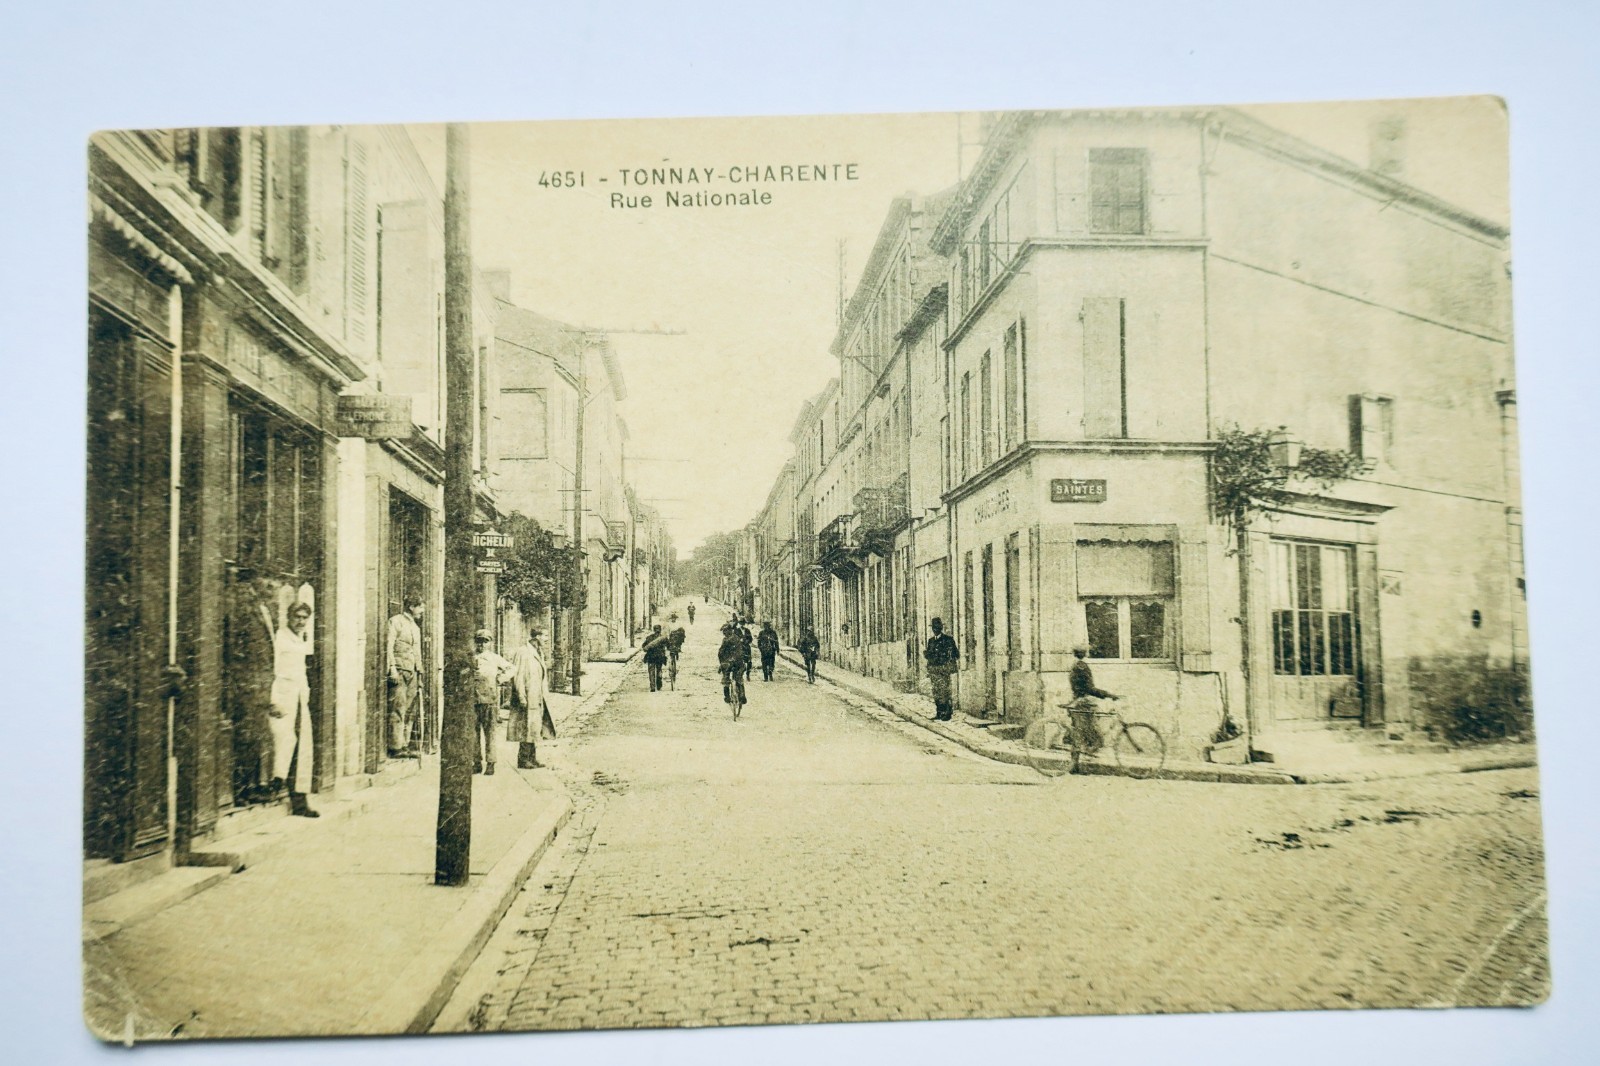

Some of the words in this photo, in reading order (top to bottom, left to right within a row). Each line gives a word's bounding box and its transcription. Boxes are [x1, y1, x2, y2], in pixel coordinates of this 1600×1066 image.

[538, 171, 585, 188] 4651
[620, 164, 859, 185] TONNAY-CHARENTE
[611, 193, 652, 208] Rue
[667, 189, 771, 207] Nationale
[1056, 485, 1103, 495] SAINTES
